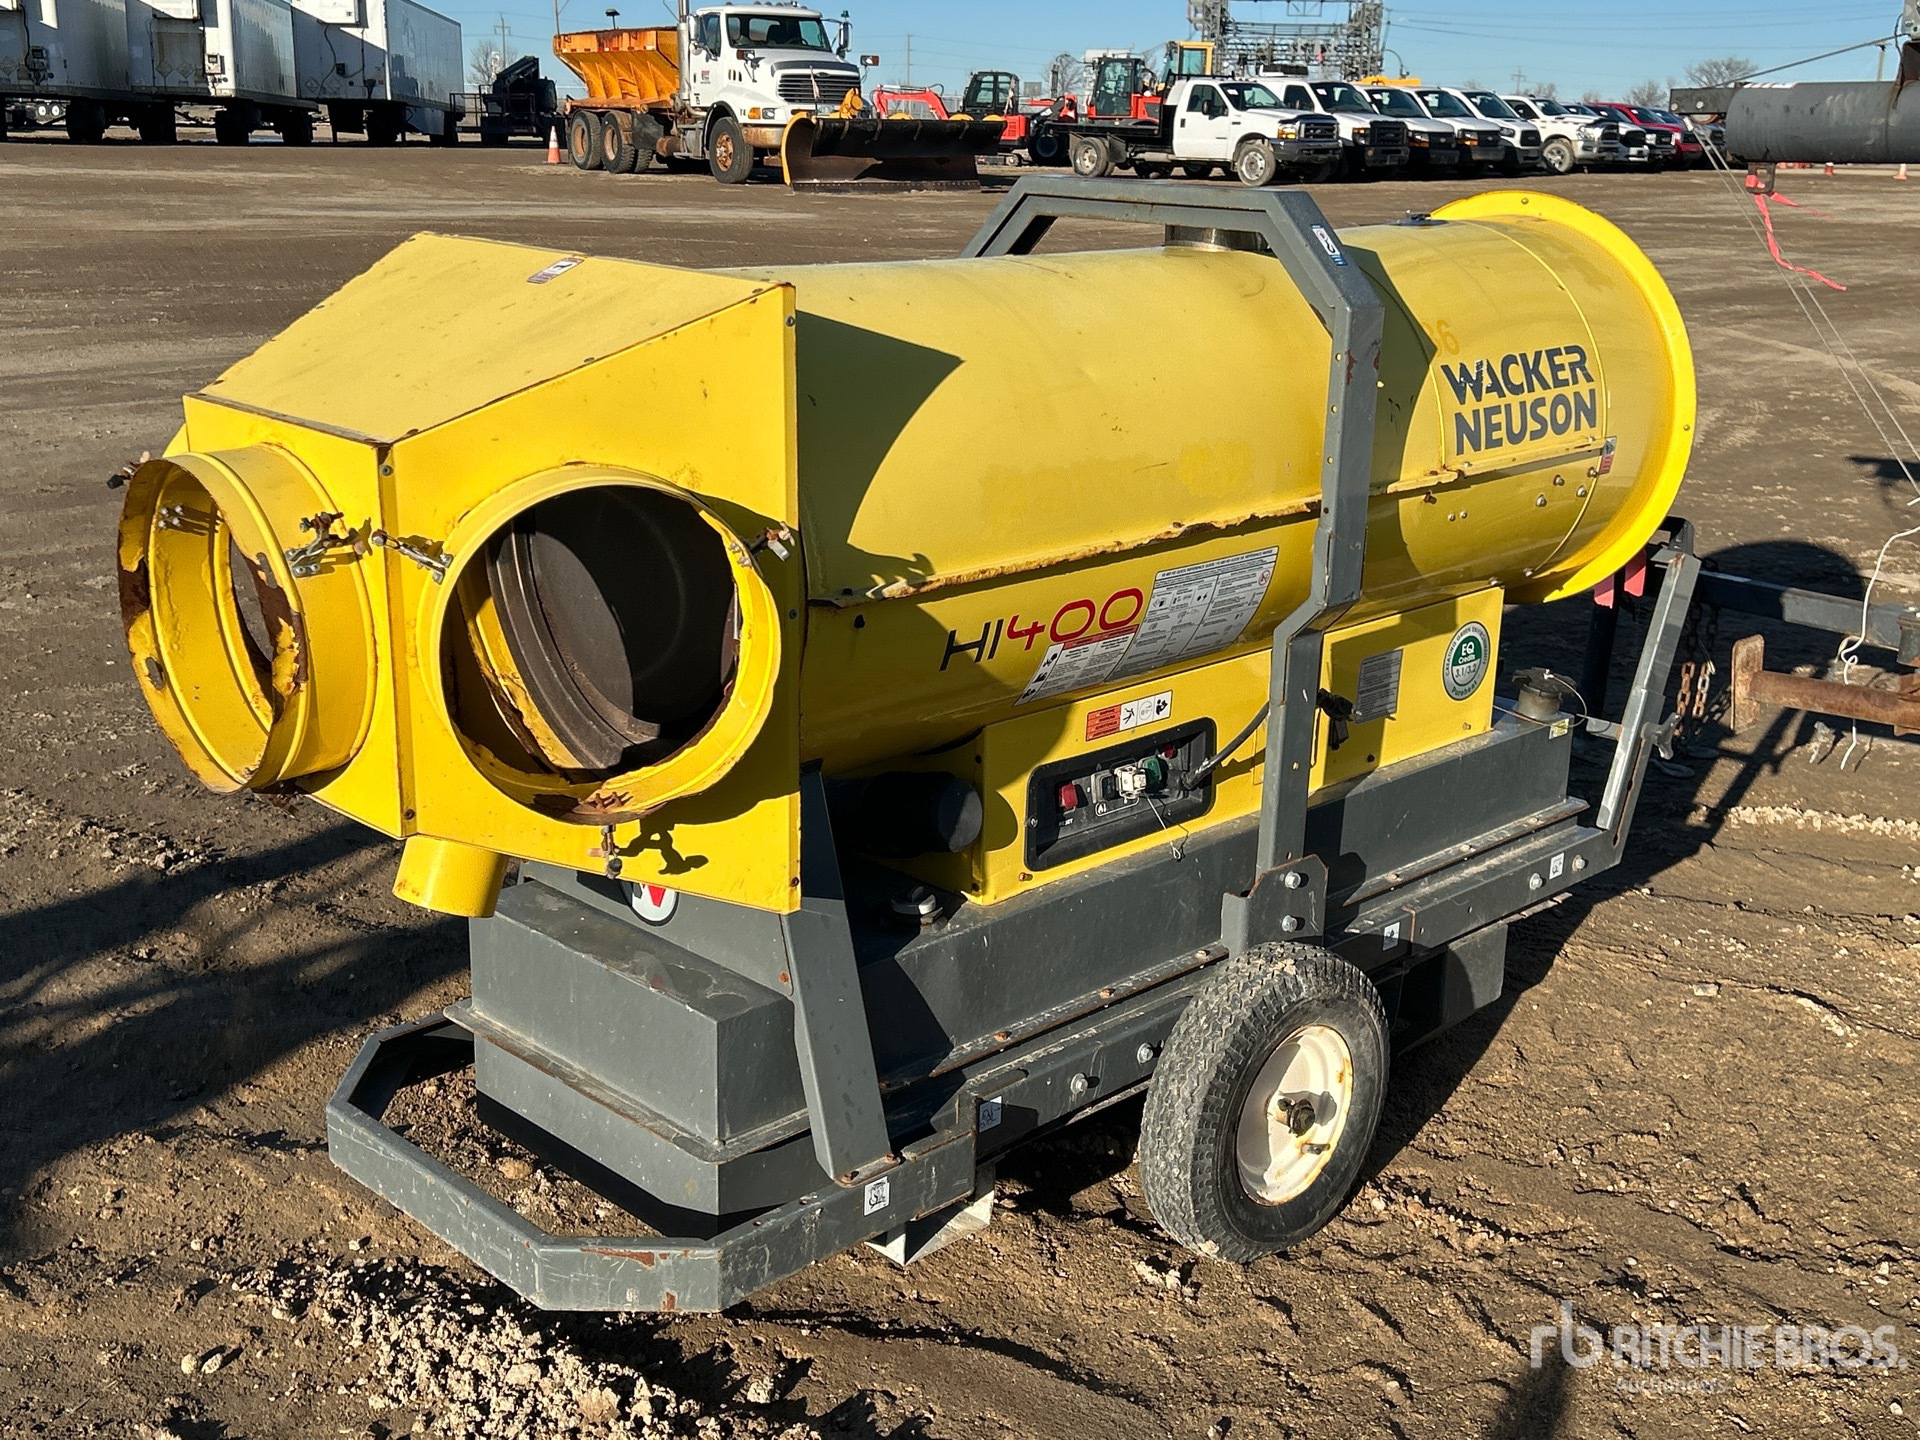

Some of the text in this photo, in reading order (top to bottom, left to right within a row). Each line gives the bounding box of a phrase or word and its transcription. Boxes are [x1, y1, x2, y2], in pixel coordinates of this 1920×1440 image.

[1440, 344, 1595, 405] WACKER
[1454, 388, 1597, 456] NEUSON
[939, 587, 1144, 672] HI400
[1461, 641, 1475, 657] EQ
